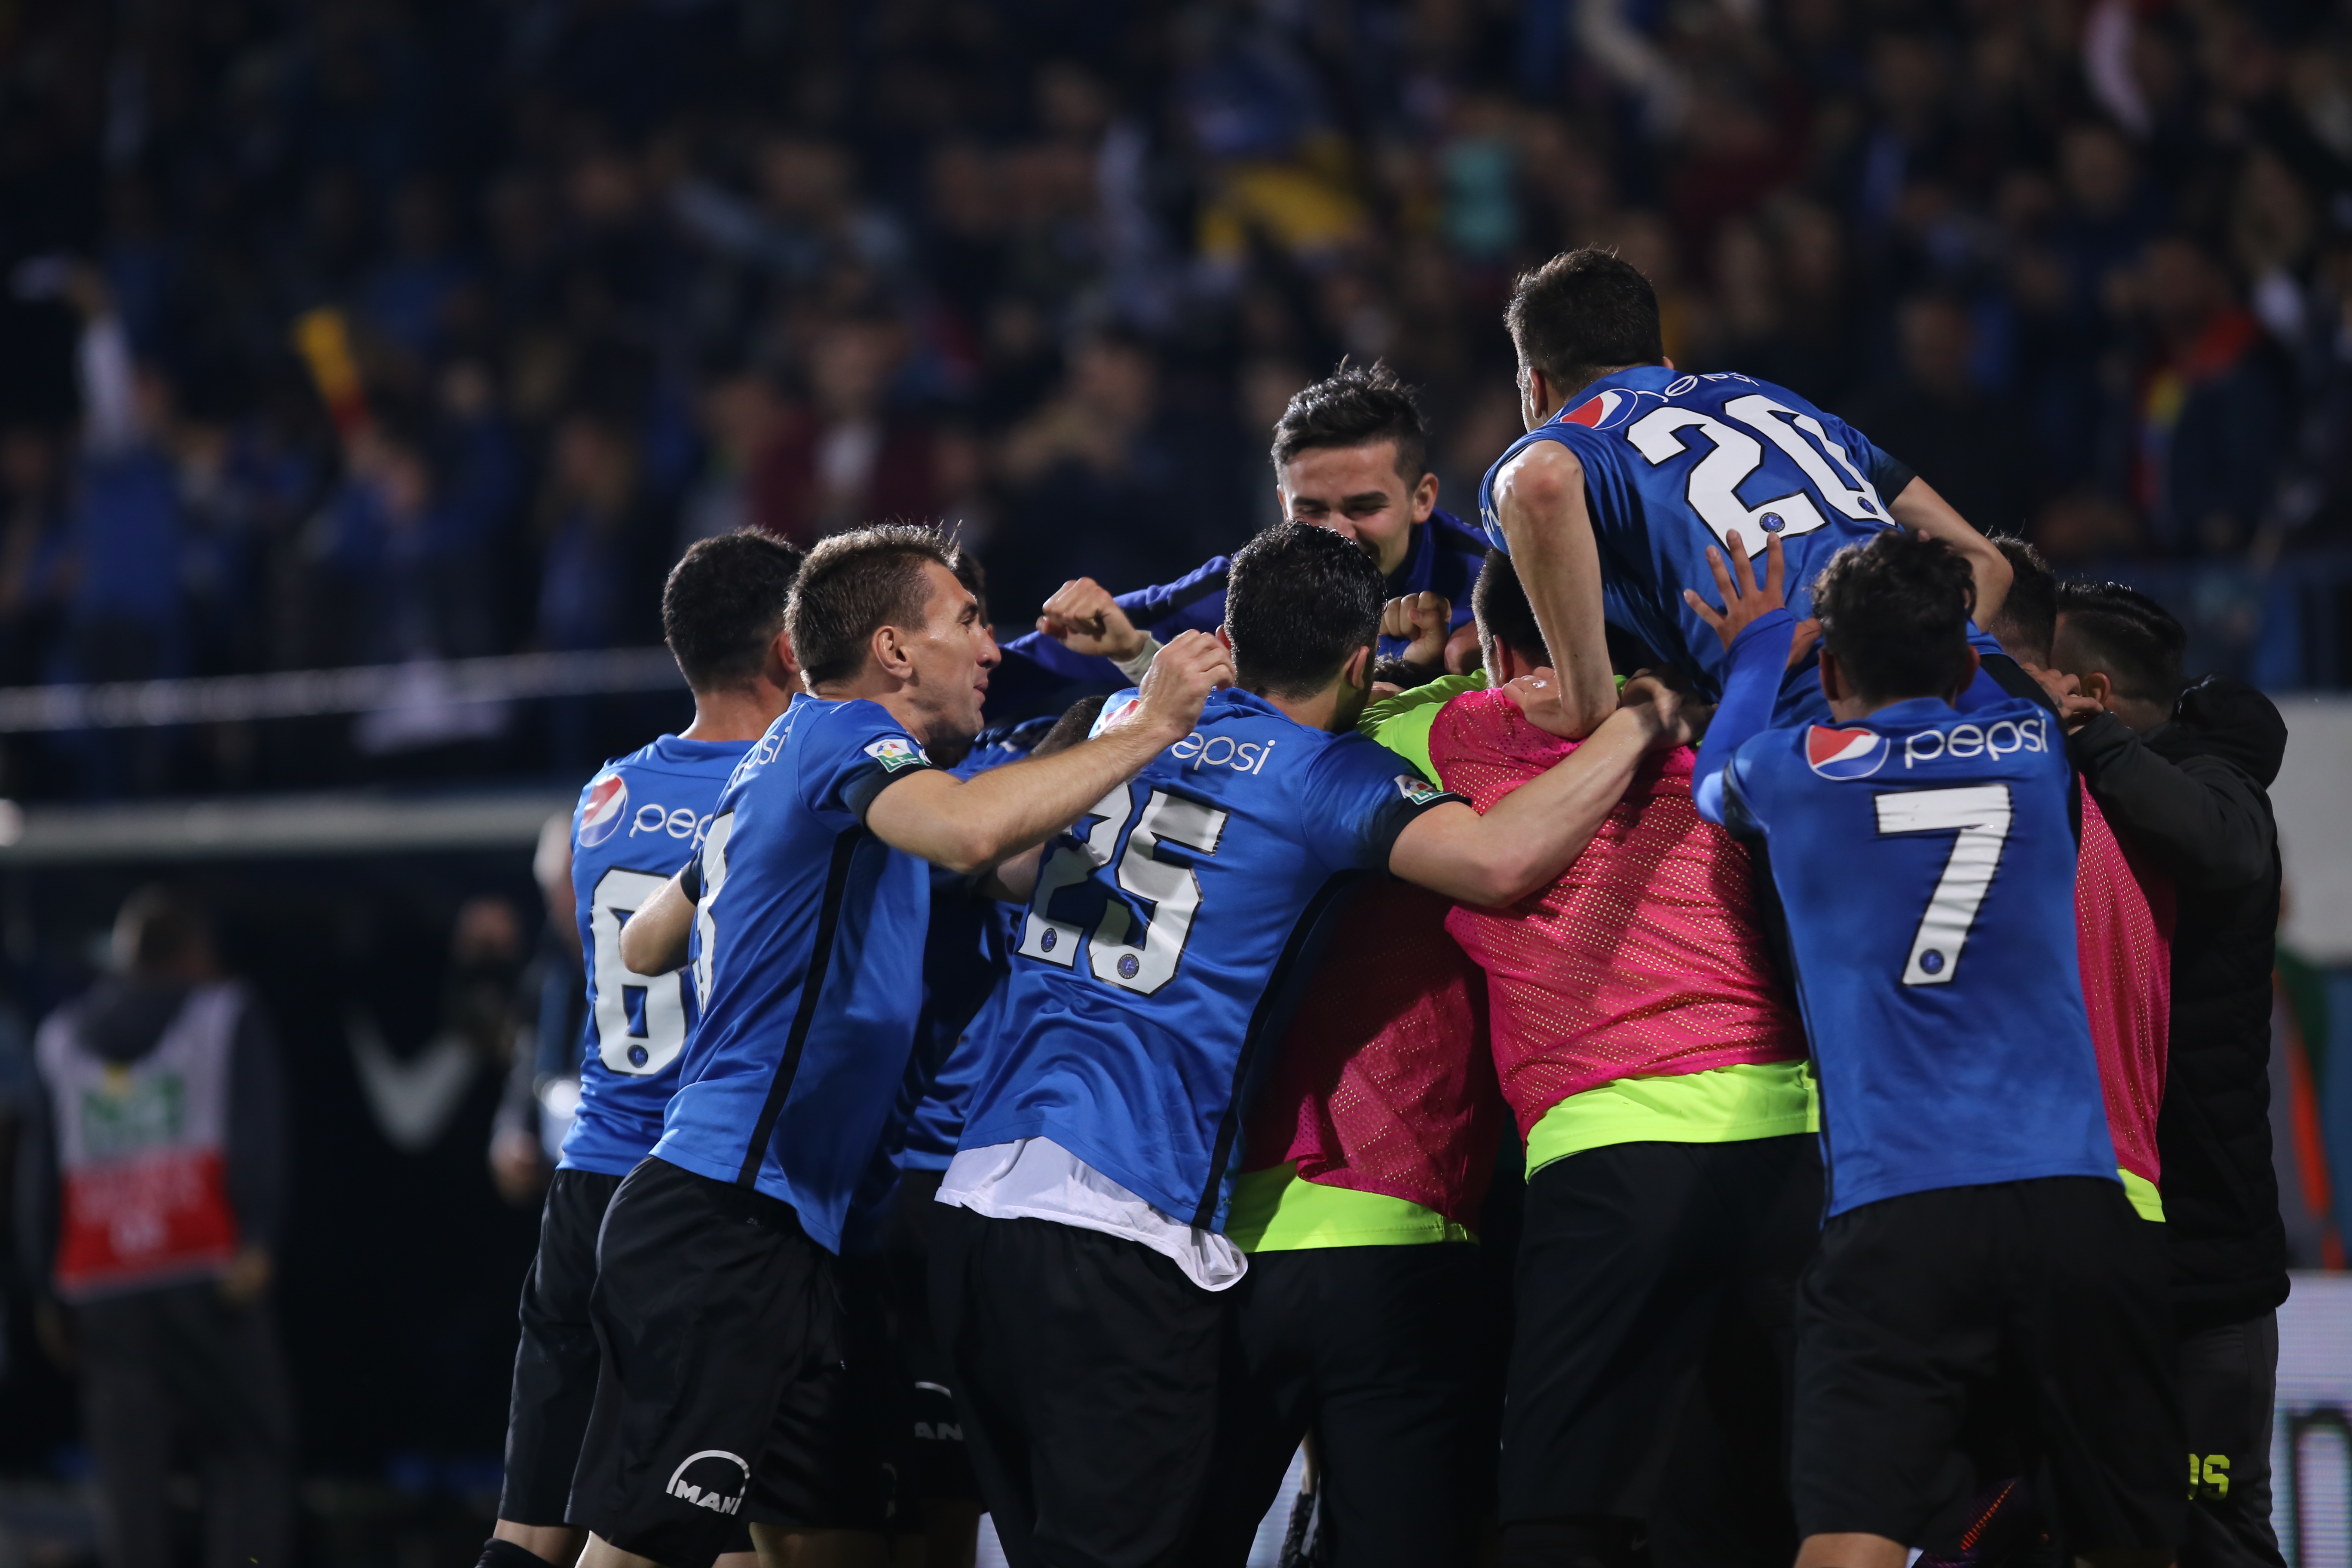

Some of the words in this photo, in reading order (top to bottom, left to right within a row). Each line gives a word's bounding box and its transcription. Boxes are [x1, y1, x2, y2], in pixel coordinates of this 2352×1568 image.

[1626, 393, 1896, 560] 20
[1171, 732, 1276, 775] epsi
[1904, 708, 2049, 769] pepsi
[628, 803, 714, 850] pep
[1015, 783, 1231, 997] 25
[1873, 784, 2012, 987] 7
[914, 1422, 964, 1441] AN
[674, 1479, 738, 1514] MAN
